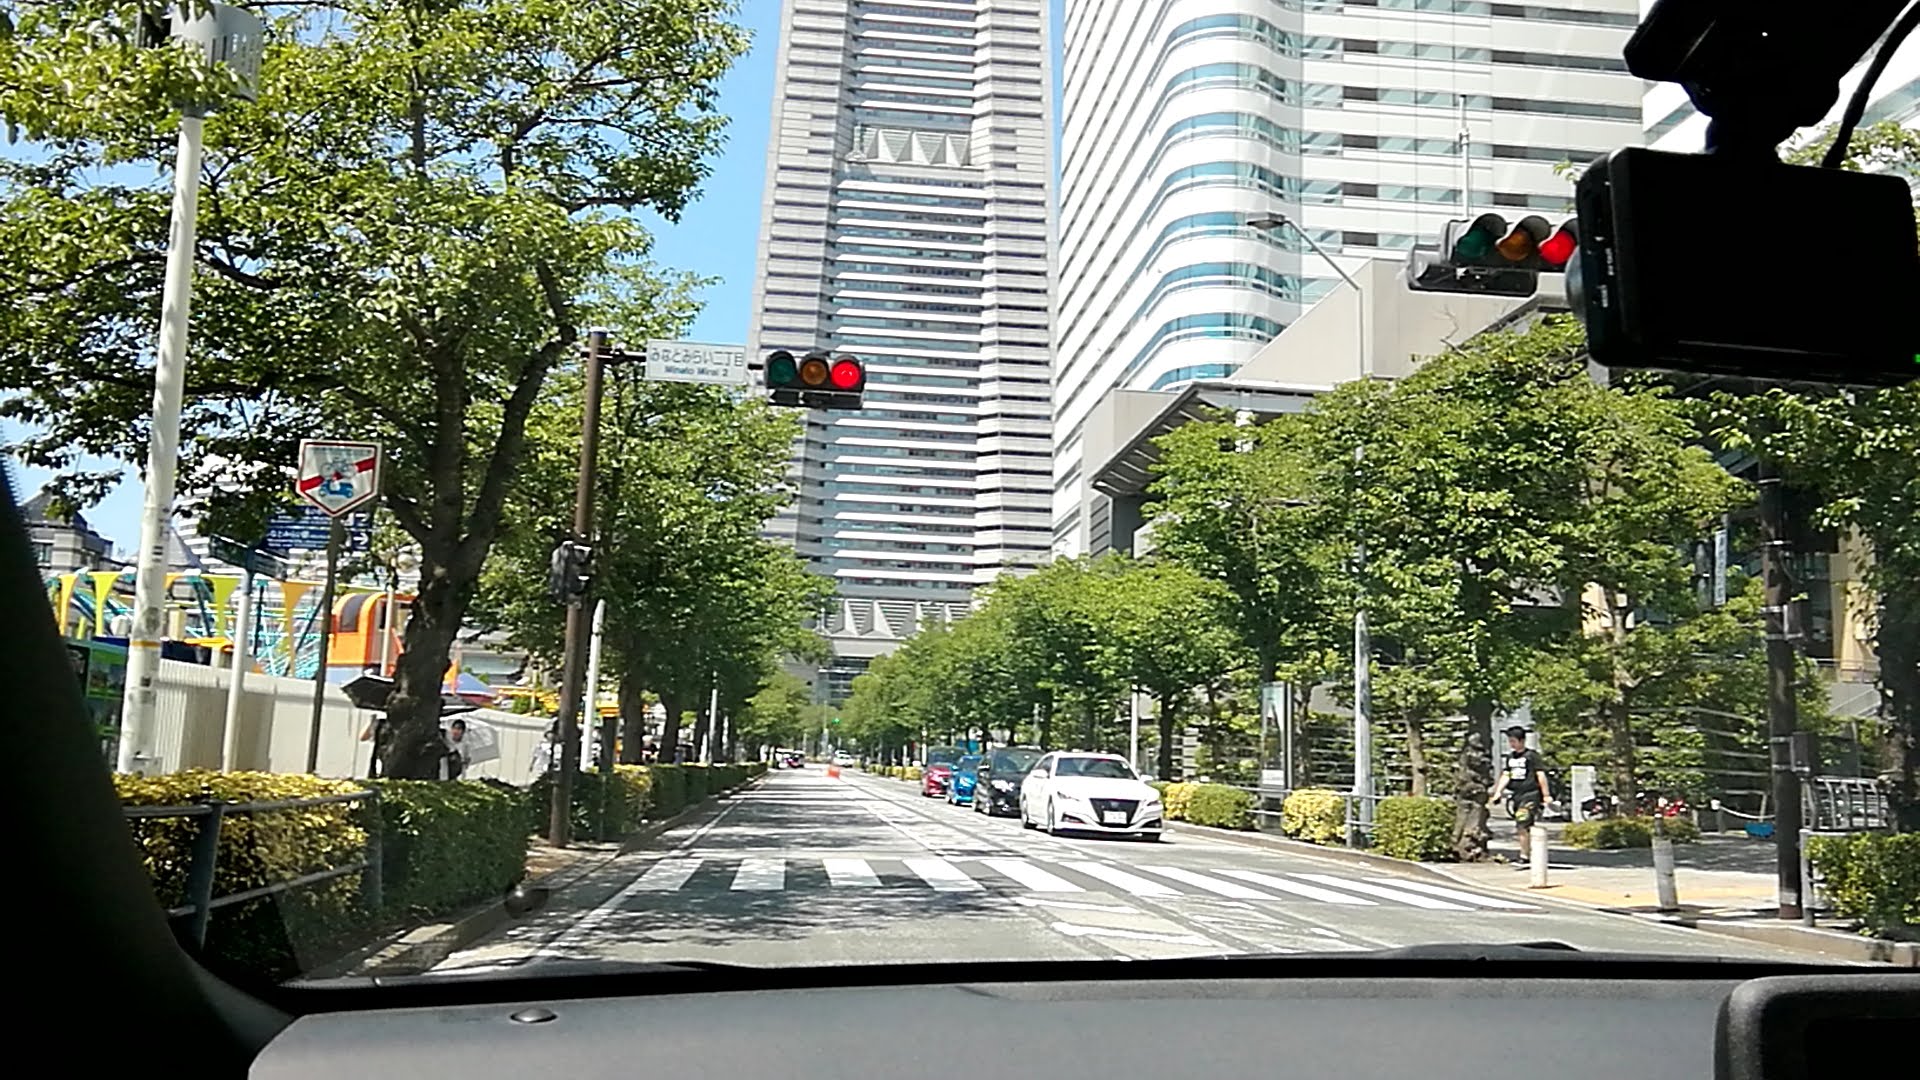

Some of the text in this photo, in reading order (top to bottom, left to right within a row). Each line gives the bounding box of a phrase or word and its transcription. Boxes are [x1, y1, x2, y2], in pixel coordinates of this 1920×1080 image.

[650, 347, 744, 367] みなとみらい二丁目
[664, 365, 729, 378] Minato Mirai 2
